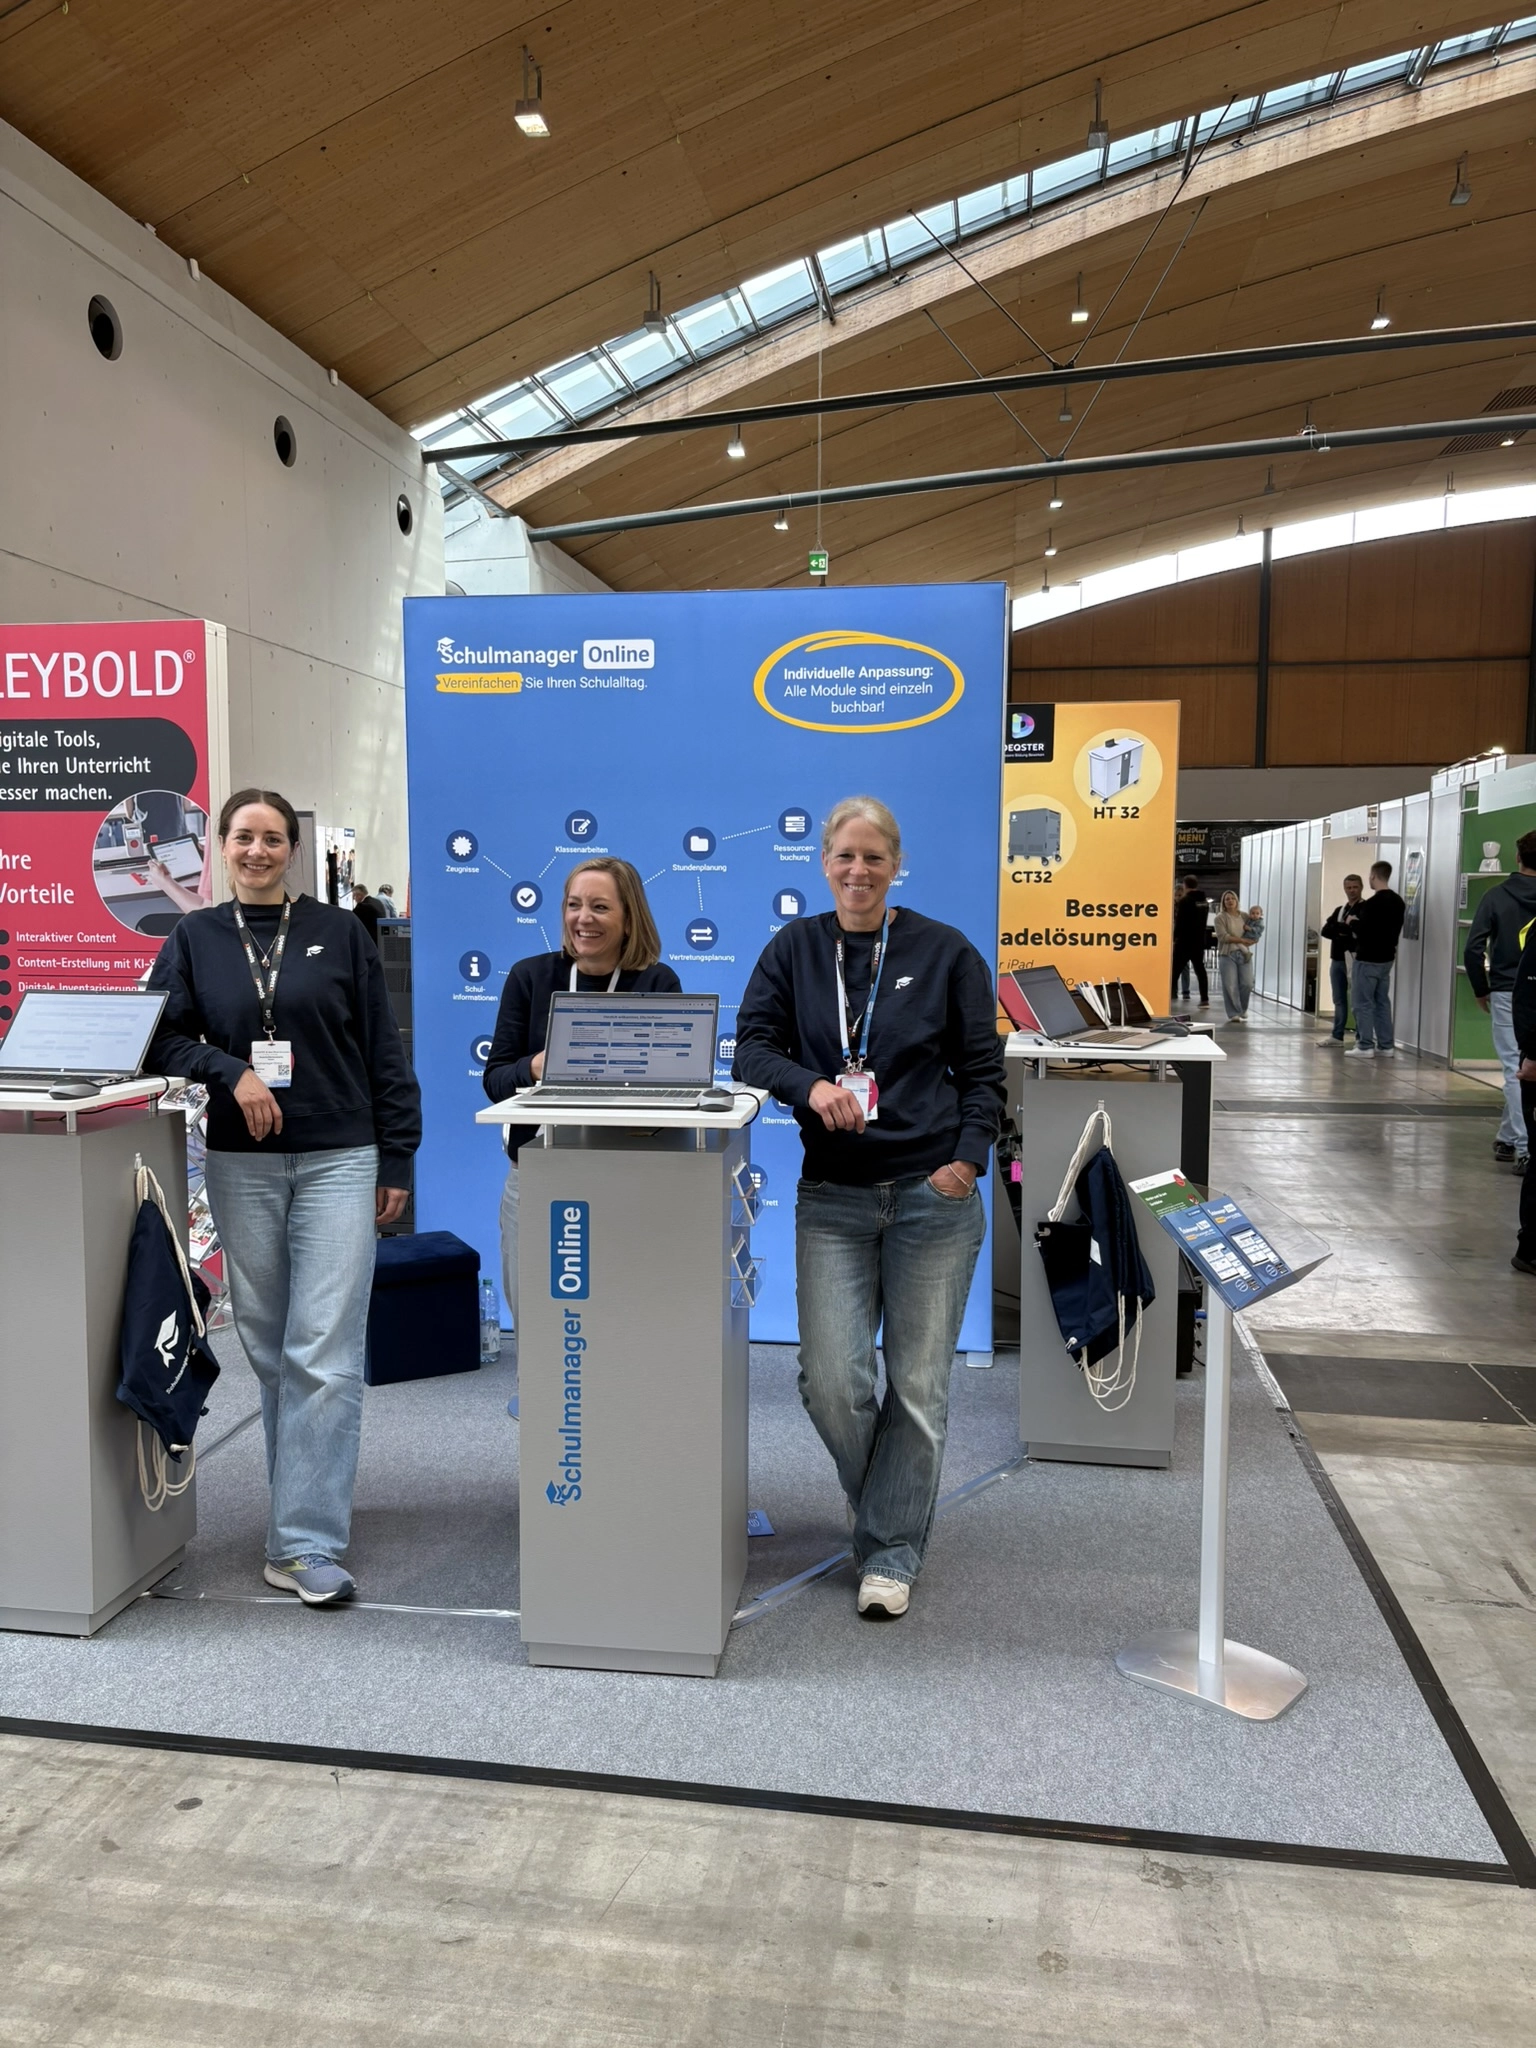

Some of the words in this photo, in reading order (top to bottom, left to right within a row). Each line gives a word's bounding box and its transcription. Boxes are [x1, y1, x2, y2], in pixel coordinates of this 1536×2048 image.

[440, 645, 578, 668] Schulmanager
[588, 645, 650, 663] Online
[0, 649, 196, 699] EYBOLD®
[783, 666, 856, 680] Individuelle
[858, 665, 934, 681] Anpassung:
[442, 677, 519, 689] Vereinfachen
[525, 677, 544, 689] Sie
[547, 677, 577, 689] Ihren
[579, 676, 648, 691] Schulalltag.
[783, 685, 807, 697] Alle
[810, 684, 857, 697] Module
[860, 683, 886, 695] sind
[889, 681, 933, 694] einzeln
[831, 701, 885, 714] buchbar!
[54, 730, 101, 749] Tools,
[18, 757, 59, 774] Ihren
[66, 756, 151, 774] Unterricht
[45, 783, 113, 801] machen.
[1093, 806, 1117, 819] HT
[1120, 806, 1140, 819] 32
[1178, 834, 1205, 842] MENU
[555, 846, 608, 854] Klassenarbeiten
[780, 854, 810, 862] buchung
[445, 865, 480, 874] Zeugnisse
[672, 864, 727, 873] Stundenplanung
[1011, 871, 1053, 884] CT32
[1065, 899, 1159, 918] Bessere
[16, 931, 74, 944] Interaktiver
[77, 932, 117, 944] Content
[1000, 928, 1158, 951] adelösungen
[17, 956, 111, 972] Content-Erstellung
[114, 958, 131, 969] mit
[669, 954, 735, 963] Vertretungsplanung
[1007, 959, 1035, 970] iPad
[464, 985, 486, 993] Schul-
[557, 1205, 582, 1294] Online
[557, 1308, 588, 1502] Schulmanager
